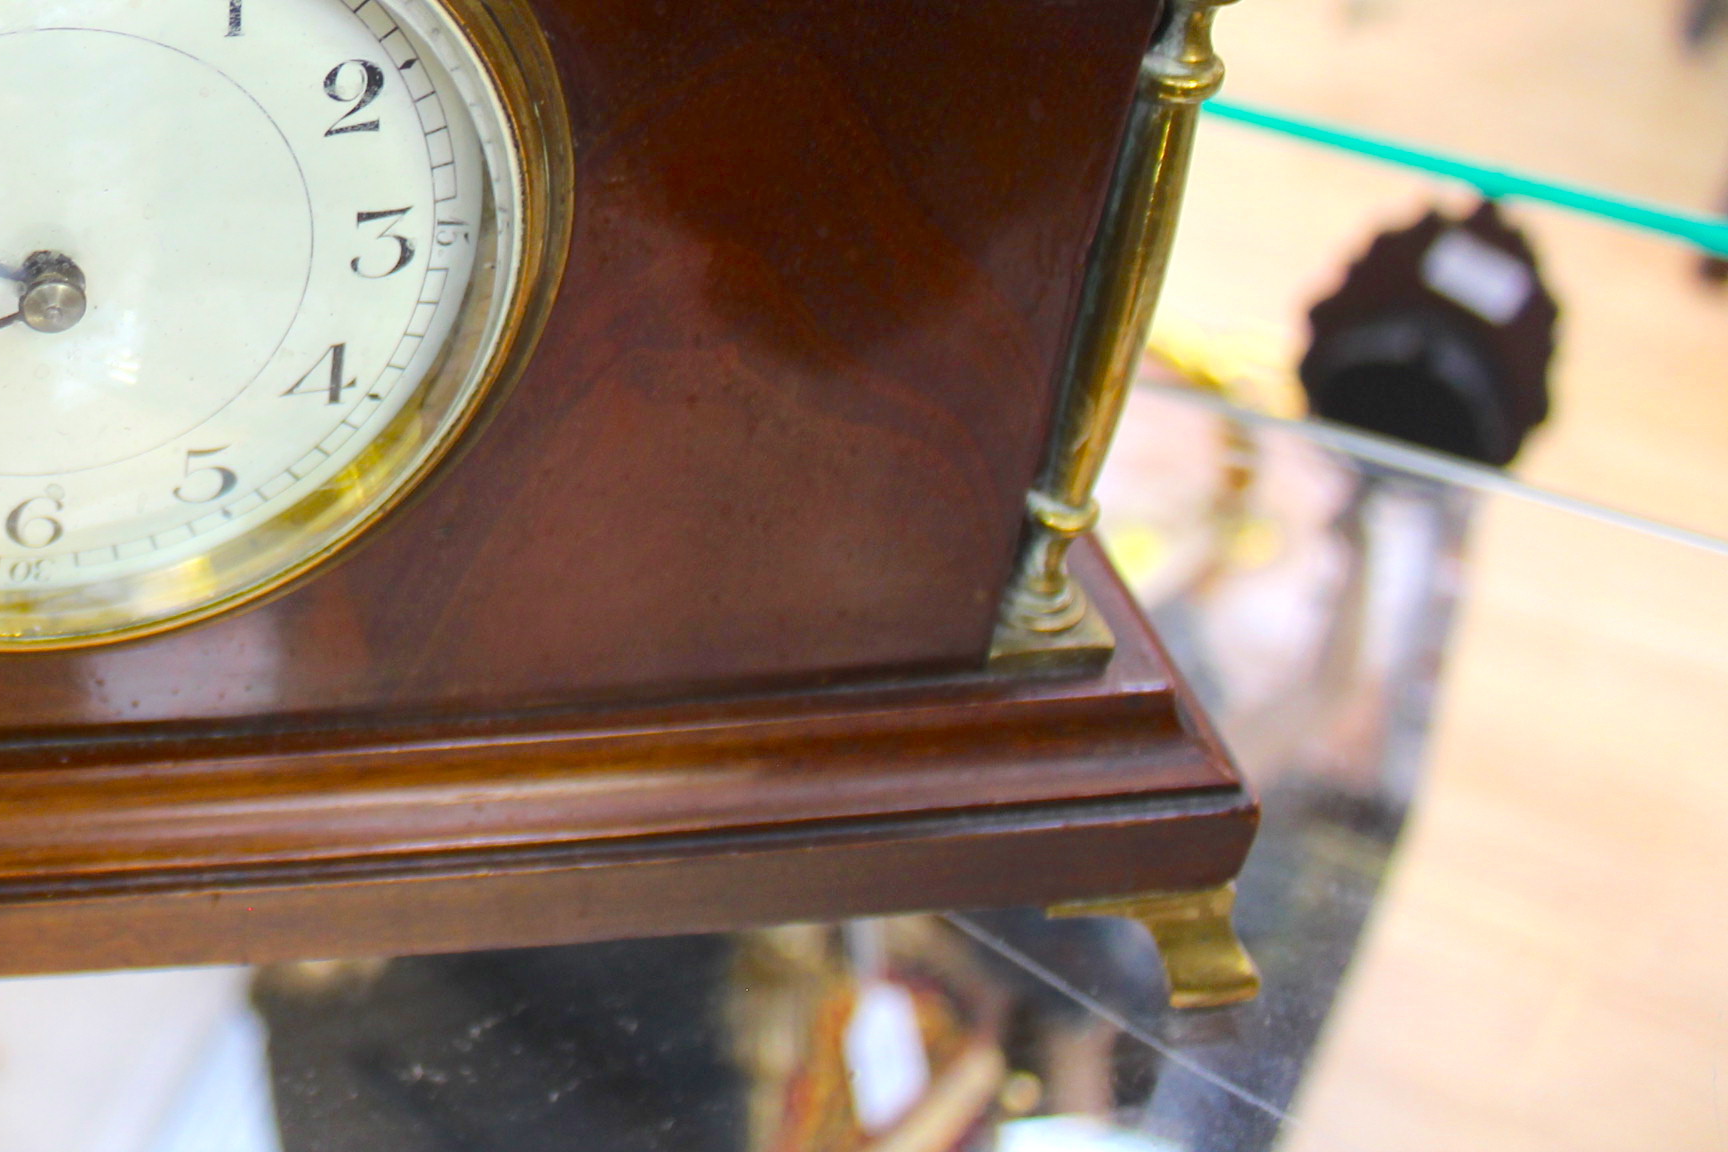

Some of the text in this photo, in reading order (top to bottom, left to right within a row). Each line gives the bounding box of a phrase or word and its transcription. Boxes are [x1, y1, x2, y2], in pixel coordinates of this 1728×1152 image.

[323, 58, 385, 138] 2
[350, 205, 416, 279] 3
[278, 342, 358, 405] 4
[172, 444, 238, 504] 5
[4, 495, 64, 549] 6
